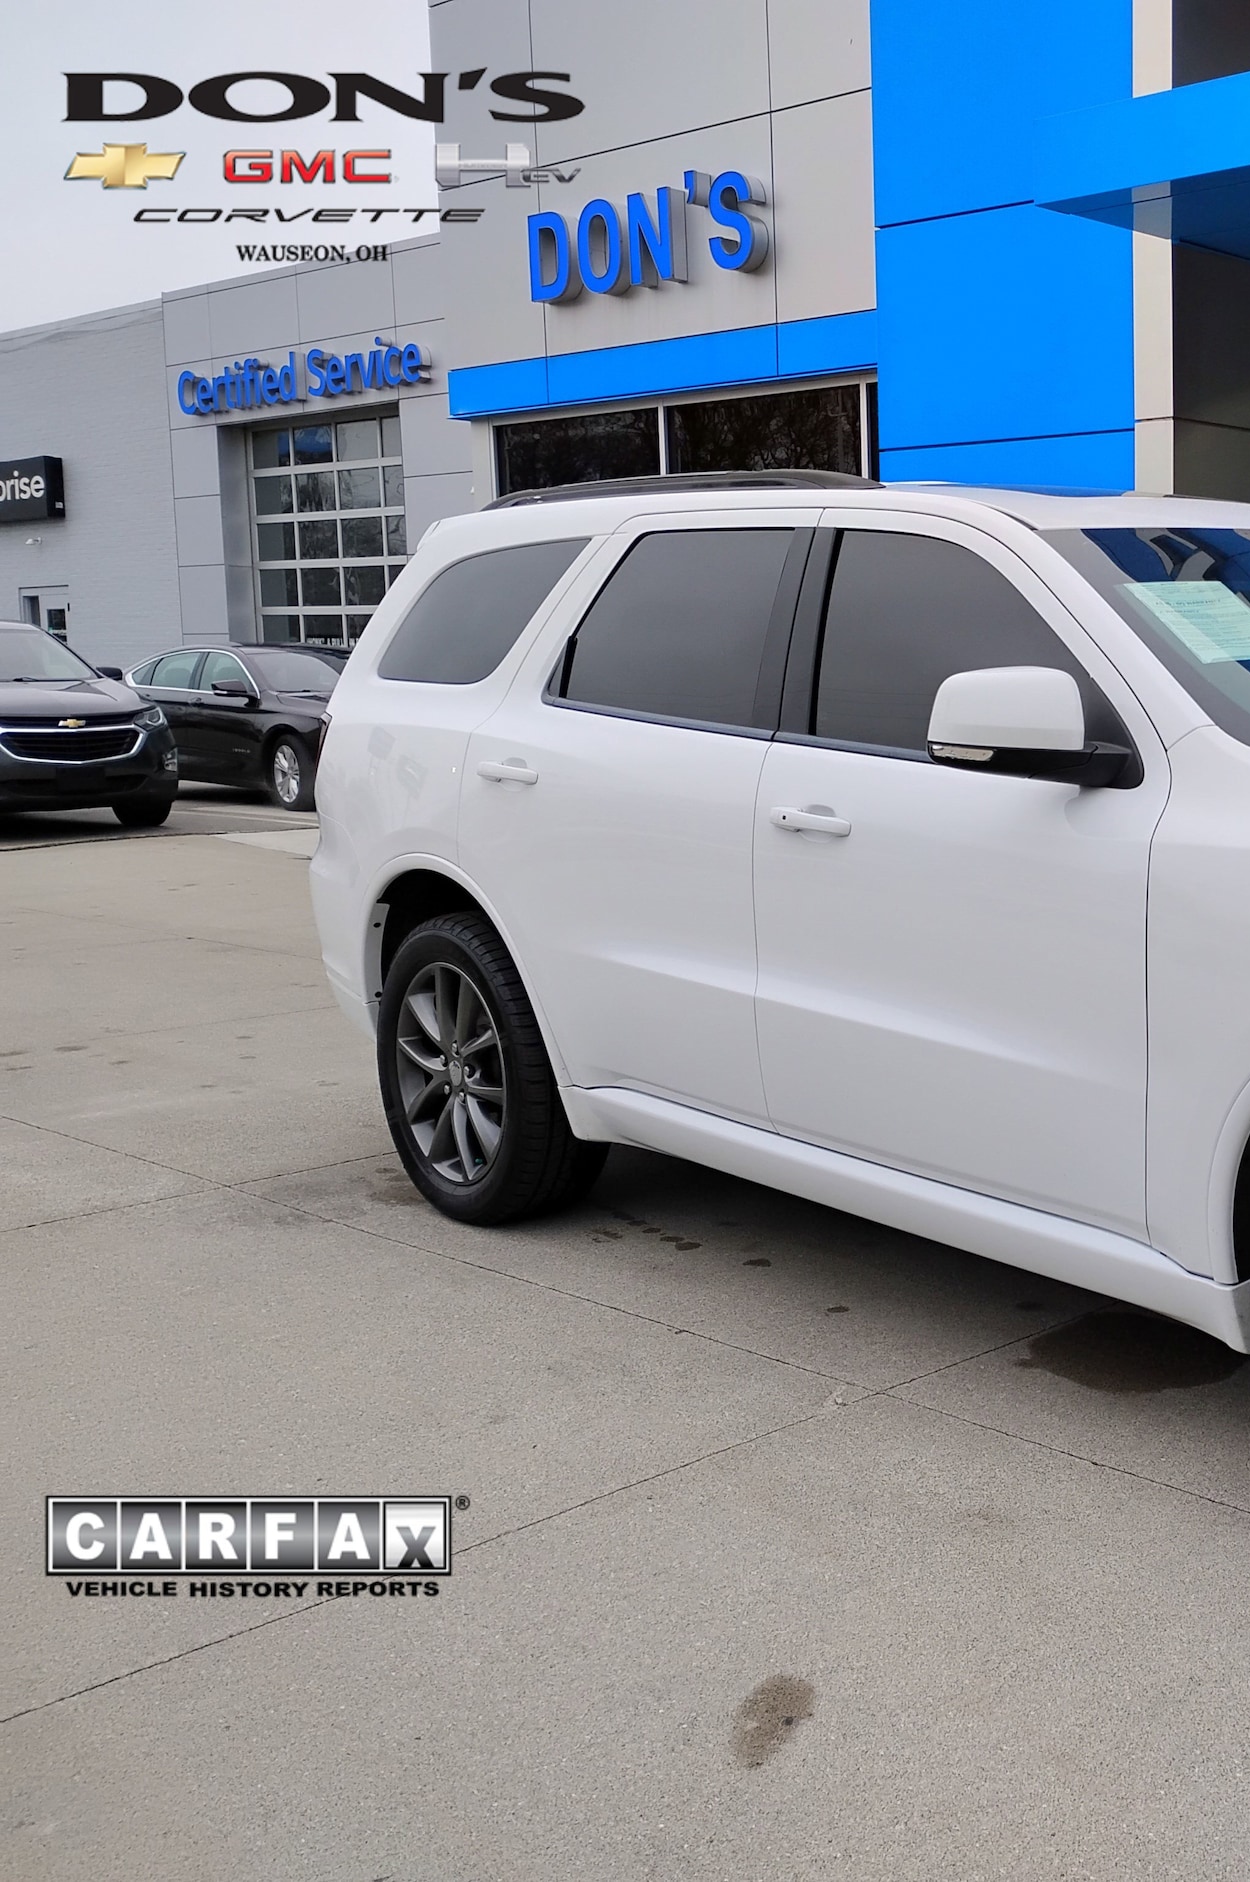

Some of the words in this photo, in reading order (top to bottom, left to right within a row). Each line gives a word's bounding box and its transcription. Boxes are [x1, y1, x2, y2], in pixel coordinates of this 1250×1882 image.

[527, 169, 762, 304] DON'S
[178, 351, 300, 415] Certified
[307, 336, 426, 397] Service
